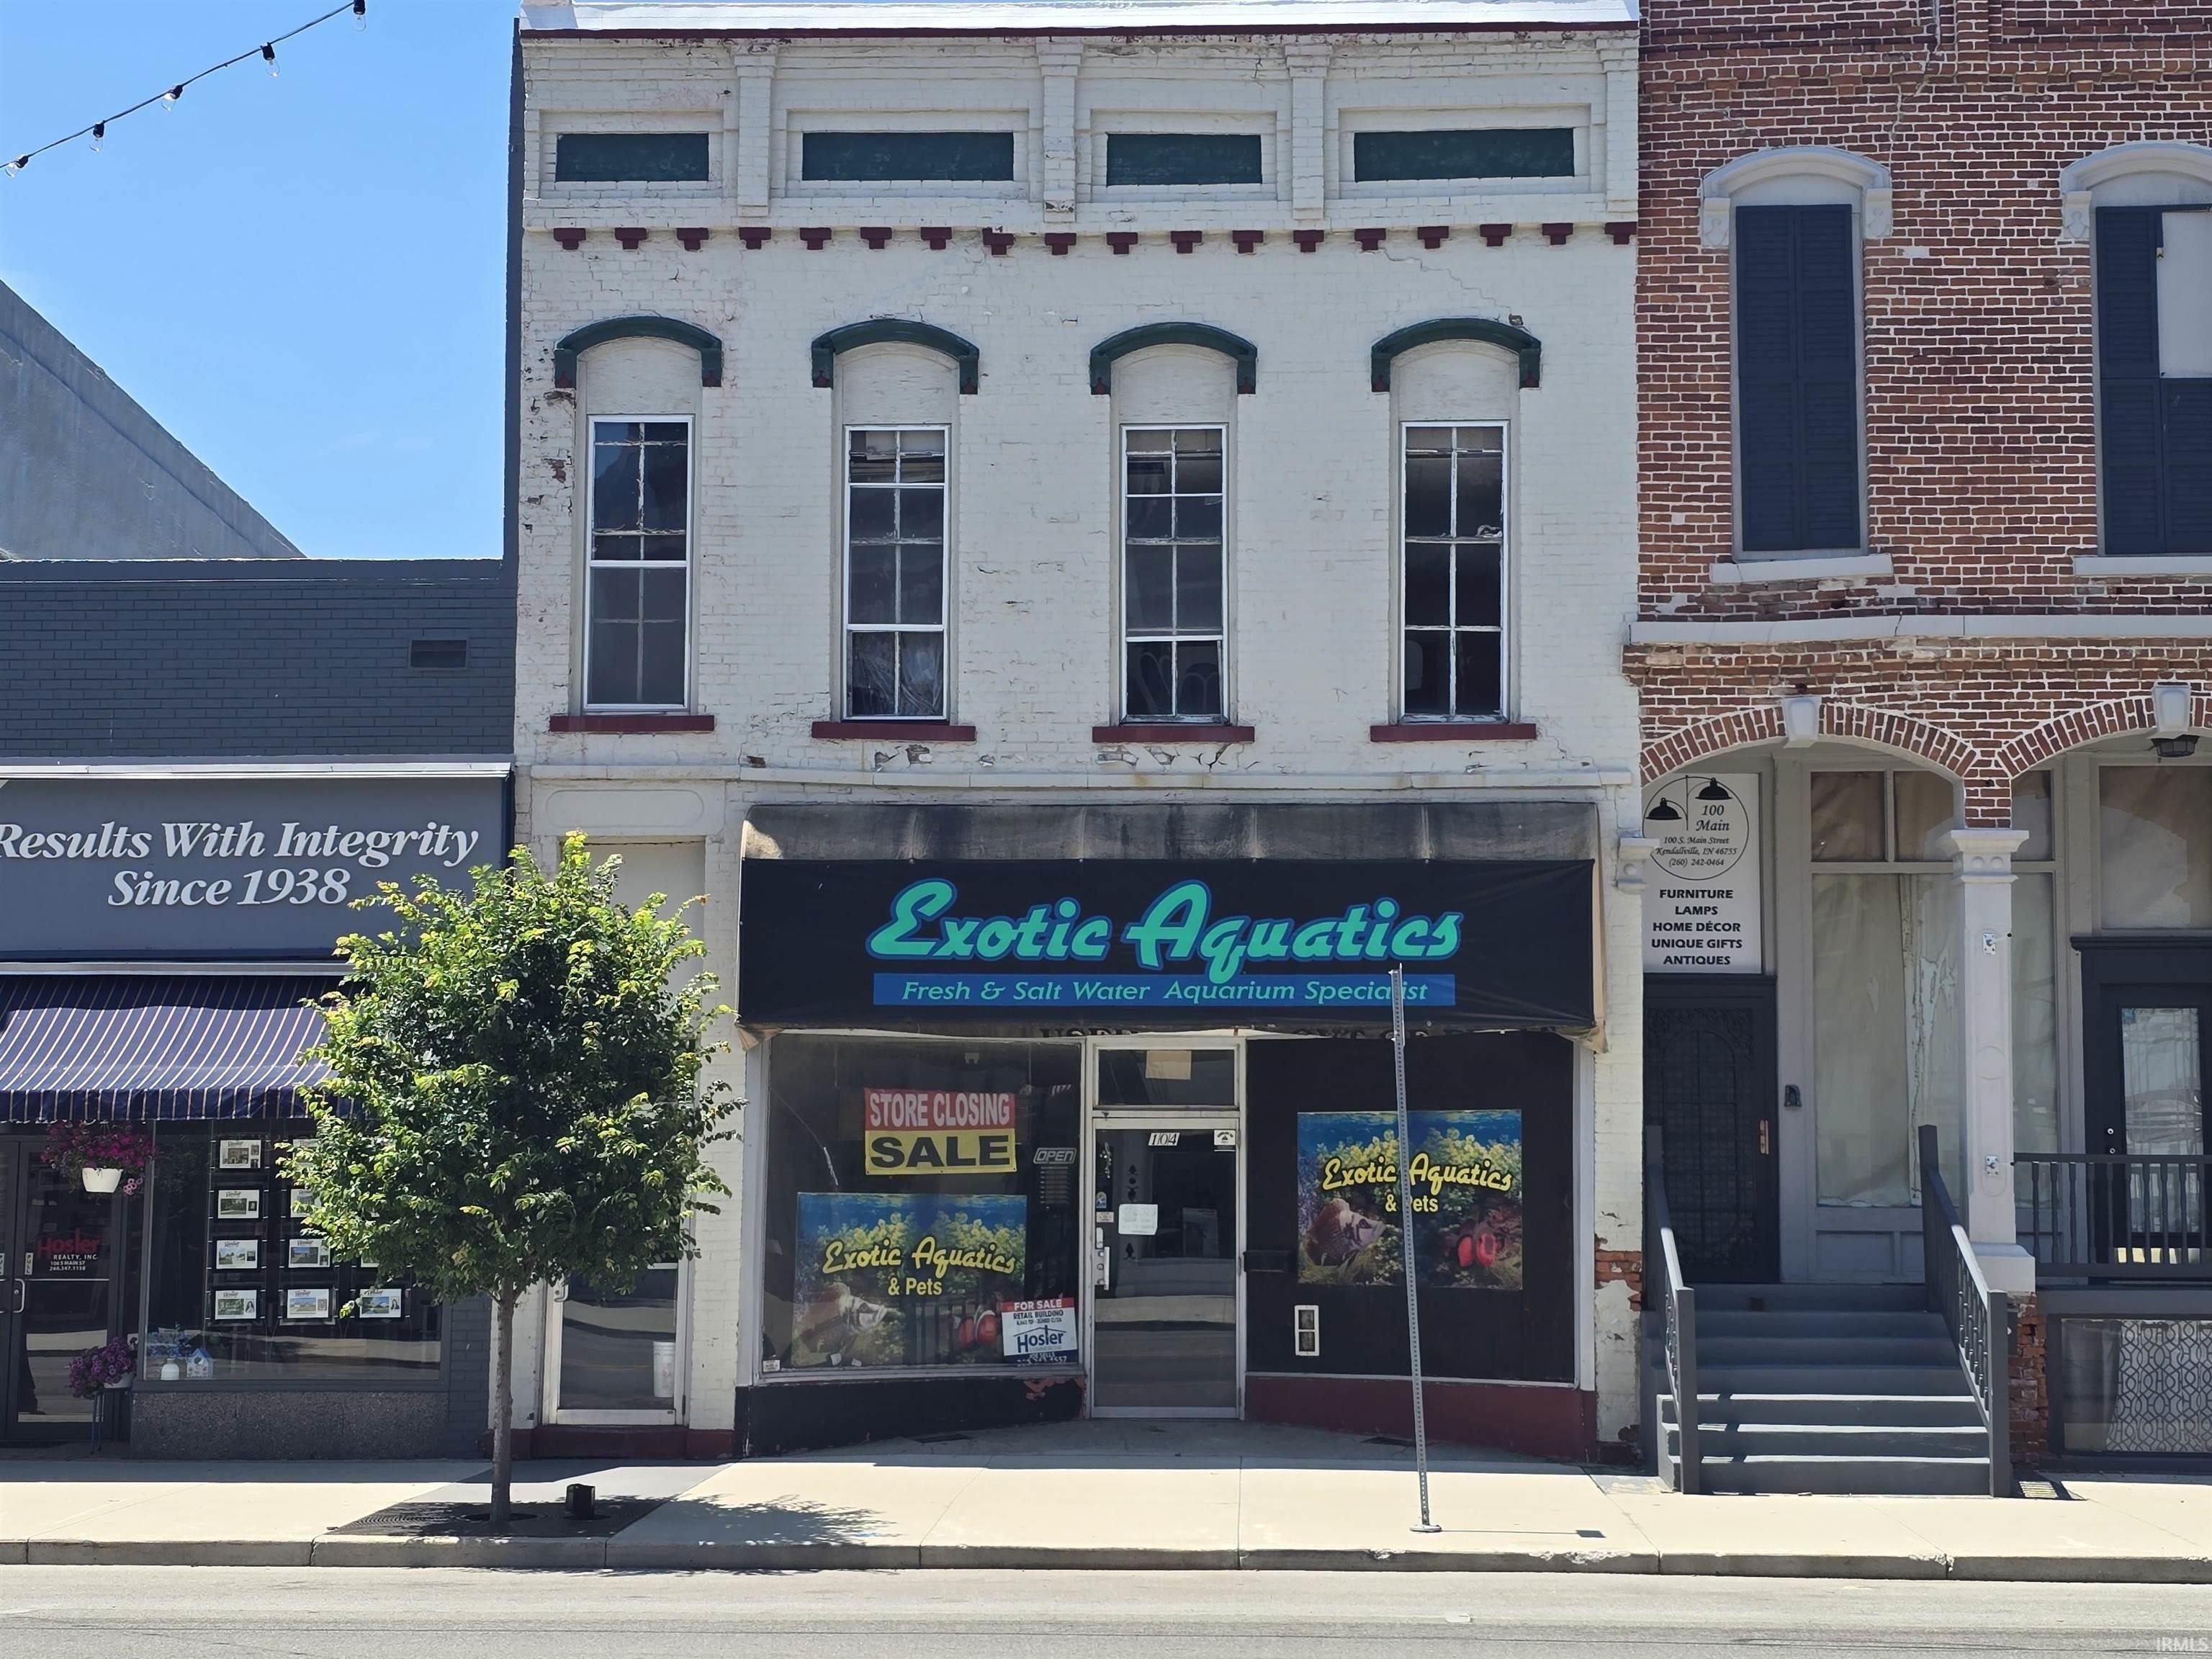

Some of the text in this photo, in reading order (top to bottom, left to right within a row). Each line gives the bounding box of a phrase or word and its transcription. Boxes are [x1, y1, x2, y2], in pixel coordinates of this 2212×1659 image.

[1701, 804, 1724, 816] 100
[1696, 819, 1730, 832] Main
[0, 821, 480, 868] Results With Integrity
[1678, 836, 1685, 845] S.
[1708, 836, 1730, 845] Street
[1656, 847, 1699, 856] Kendallville,
[1669, 858, 1688, 868] (260)
[108, 868, 351, 906] Since 1938
[1660, 889, 1733, 899] FURNITURE
[1675, 906, 1718, 915] LAMPS
[866, 878, 1464, 985] Exotic Aquatics
[1653, 920, 1740, 932] HOME DÉCOR
[1651, 939, 1743, 949] UNIQUE GIFTS
[1663, 956, 1731, 966] ANTIQUES
[902, 980, 1427, 1004] Fresh & Salt Water Aquarium Speciaist
[870, 1092, 1009, 1127] STORE CLOSING
[1150, 1133, 1179, 1146] 104
[871, 1134, 1011, 1168] SALE
[1037, 1151, 1074, 1161] OPEN
[1323, 1153, 1511, 1195] Exotic Aquatics
[1385, 1193, 1397, 1213] &
[37, 1228, 102, 1258] Hosler
[823, 1236, 1016, 1277] Exotic Aquatics
[888, 1277, 942, 1295] & Pets
[1014, 1299, 1063, 1310] FOR SALE
[1017, 1325, 1064, 1353] Hosler
